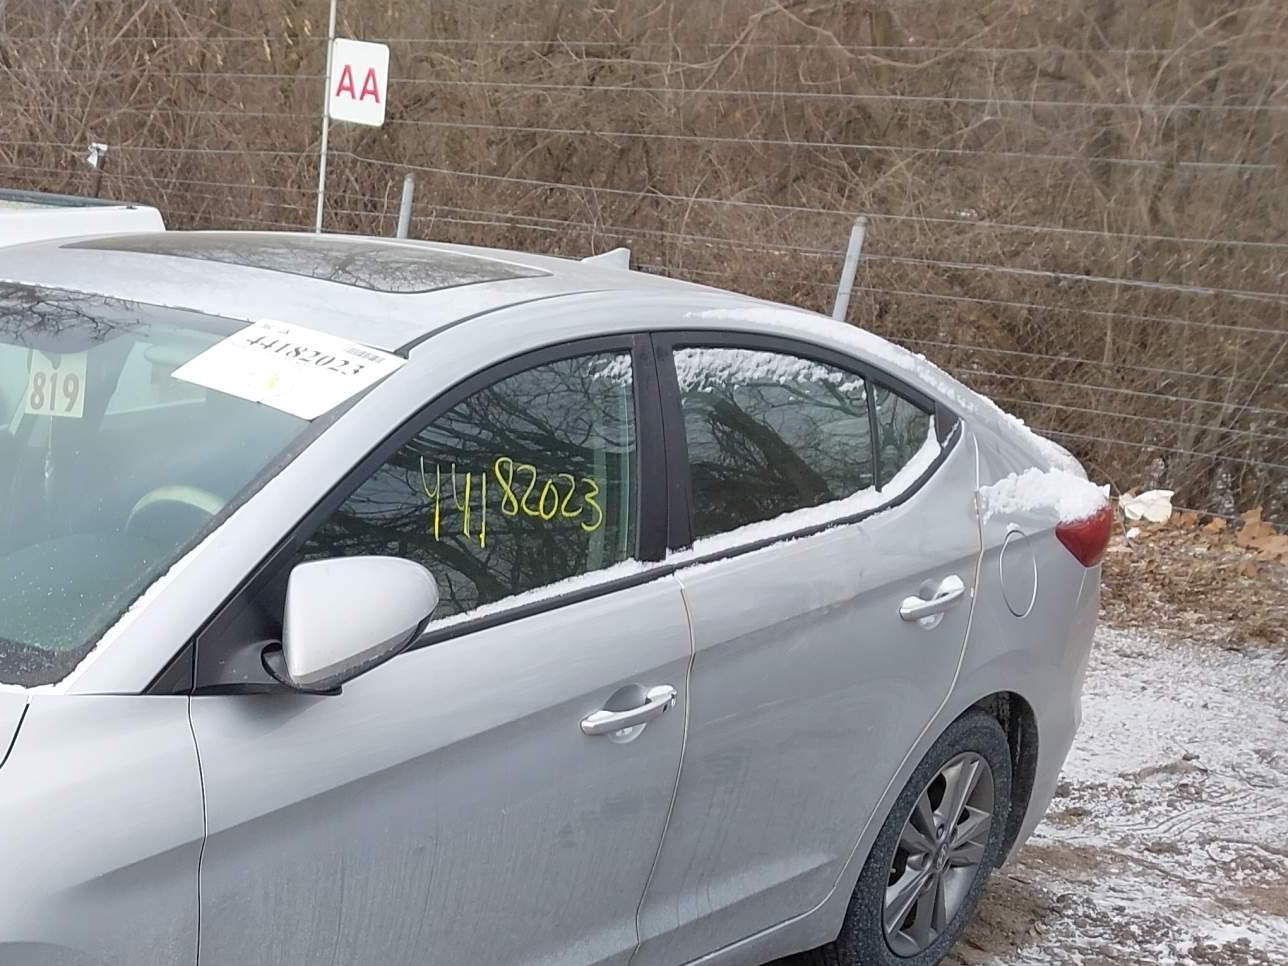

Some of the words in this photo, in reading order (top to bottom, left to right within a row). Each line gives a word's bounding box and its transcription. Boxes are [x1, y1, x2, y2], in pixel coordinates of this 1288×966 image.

[335, 64, 380, 104] AA
[245, 334, 365, 376] 44182023
[30, 371, 80, 413] 819
[420, 455, 603, 549] 44182023
